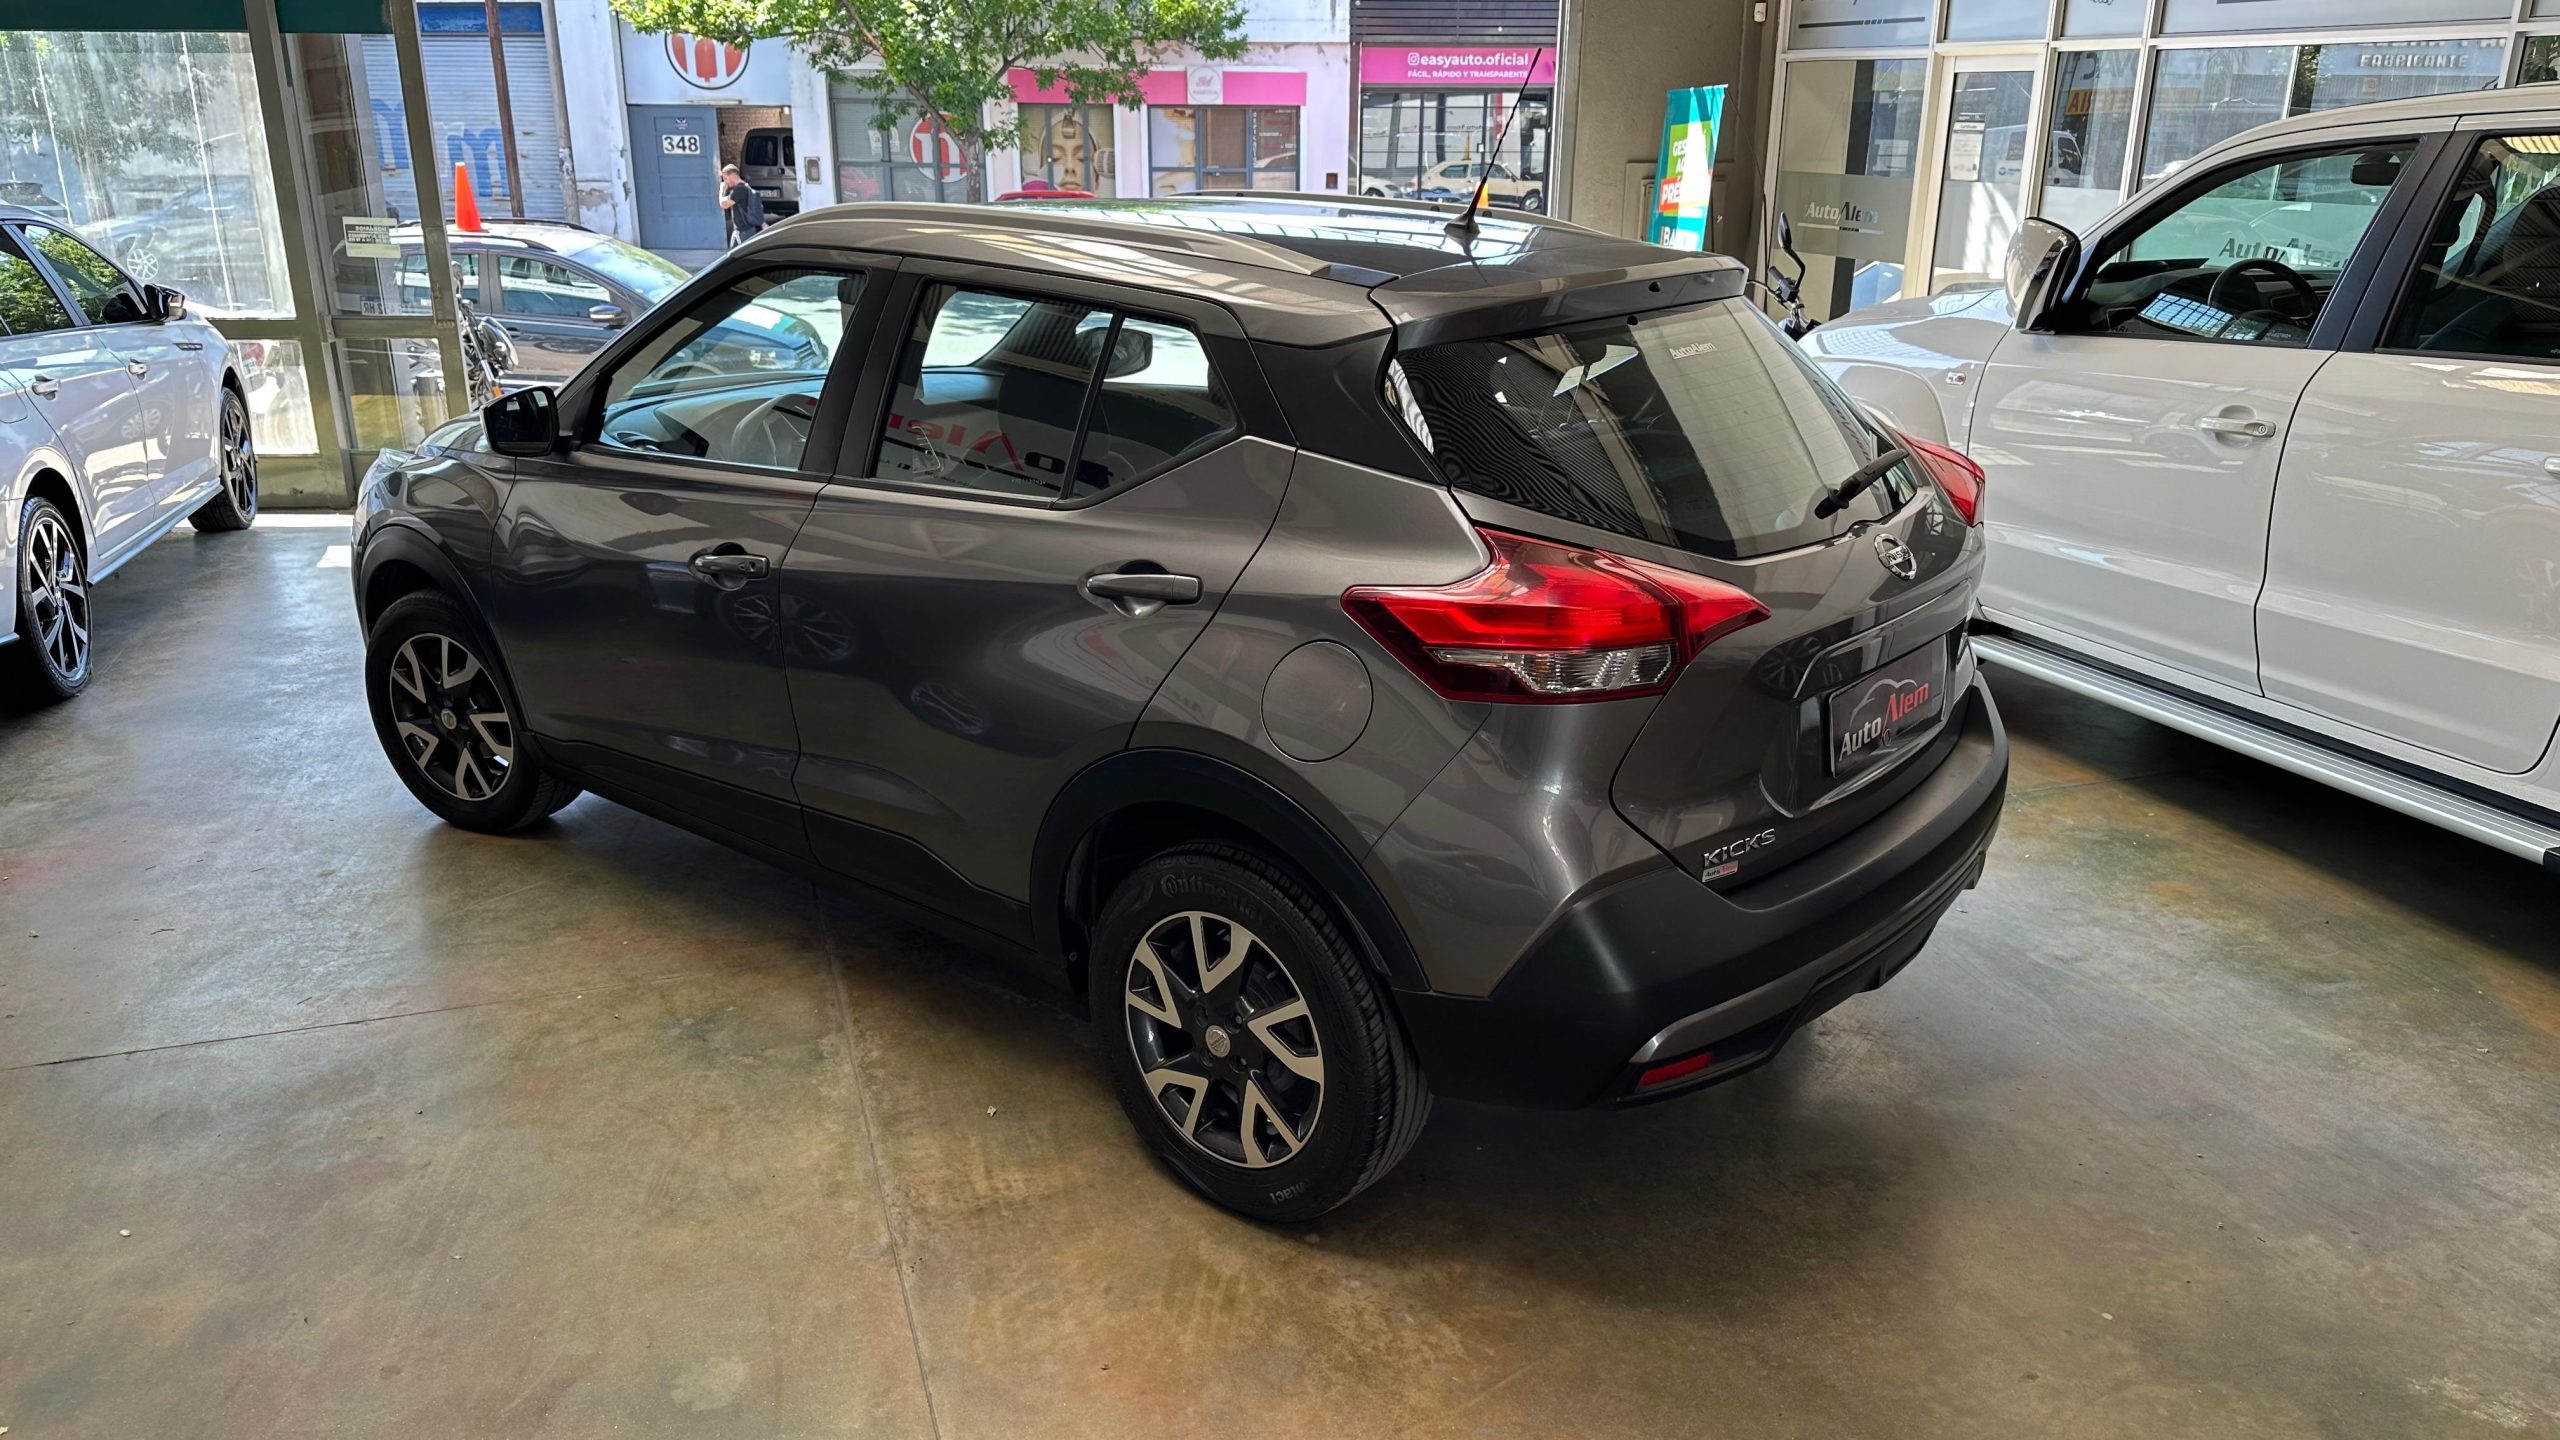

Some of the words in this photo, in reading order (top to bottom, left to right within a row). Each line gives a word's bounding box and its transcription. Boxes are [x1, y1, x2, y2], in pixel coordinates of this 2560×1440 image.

[1432, 69, 1462, 78] RÁPIDO
[664, 136, 699, 153] 348
[1703, 828, 1776, 868] KICKS
